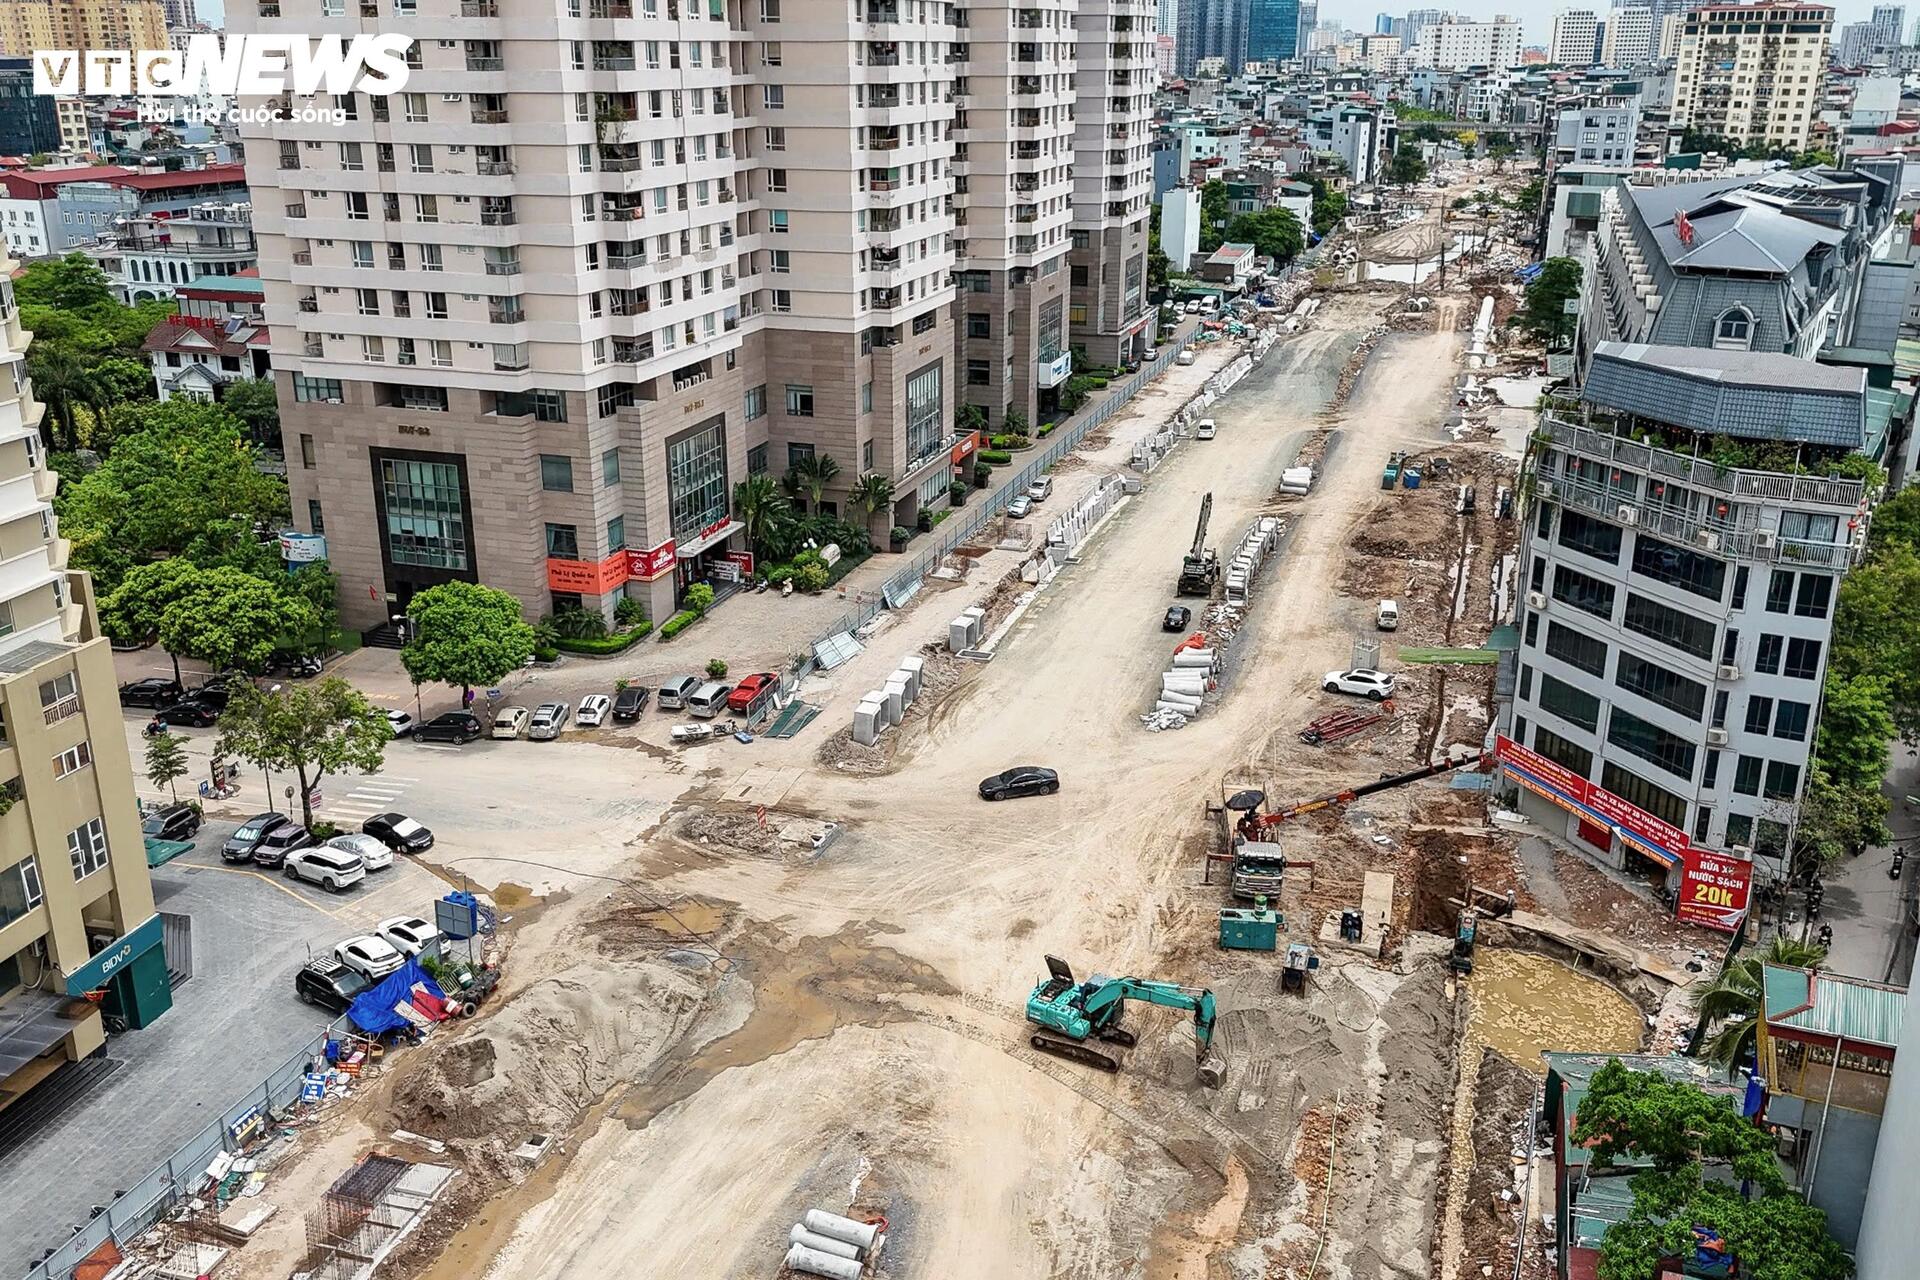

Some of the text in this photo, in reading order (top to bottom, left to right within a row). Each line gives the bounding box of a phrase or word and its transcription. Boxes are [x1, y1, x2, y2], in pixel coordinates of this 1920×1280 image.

[1595, 789, 1608, 800] SỬA
[1609, 797, 1617, 806] XE
[1617, 801, 1632, 814] MÁY
[1641, 813, 1664, 831] THÀNH
[1700, 860, 1720, 873] RỬA
[1688, 870, 1744, 889] NƯỚC SẠCH
[102, 950, 124, 973] BIDV
